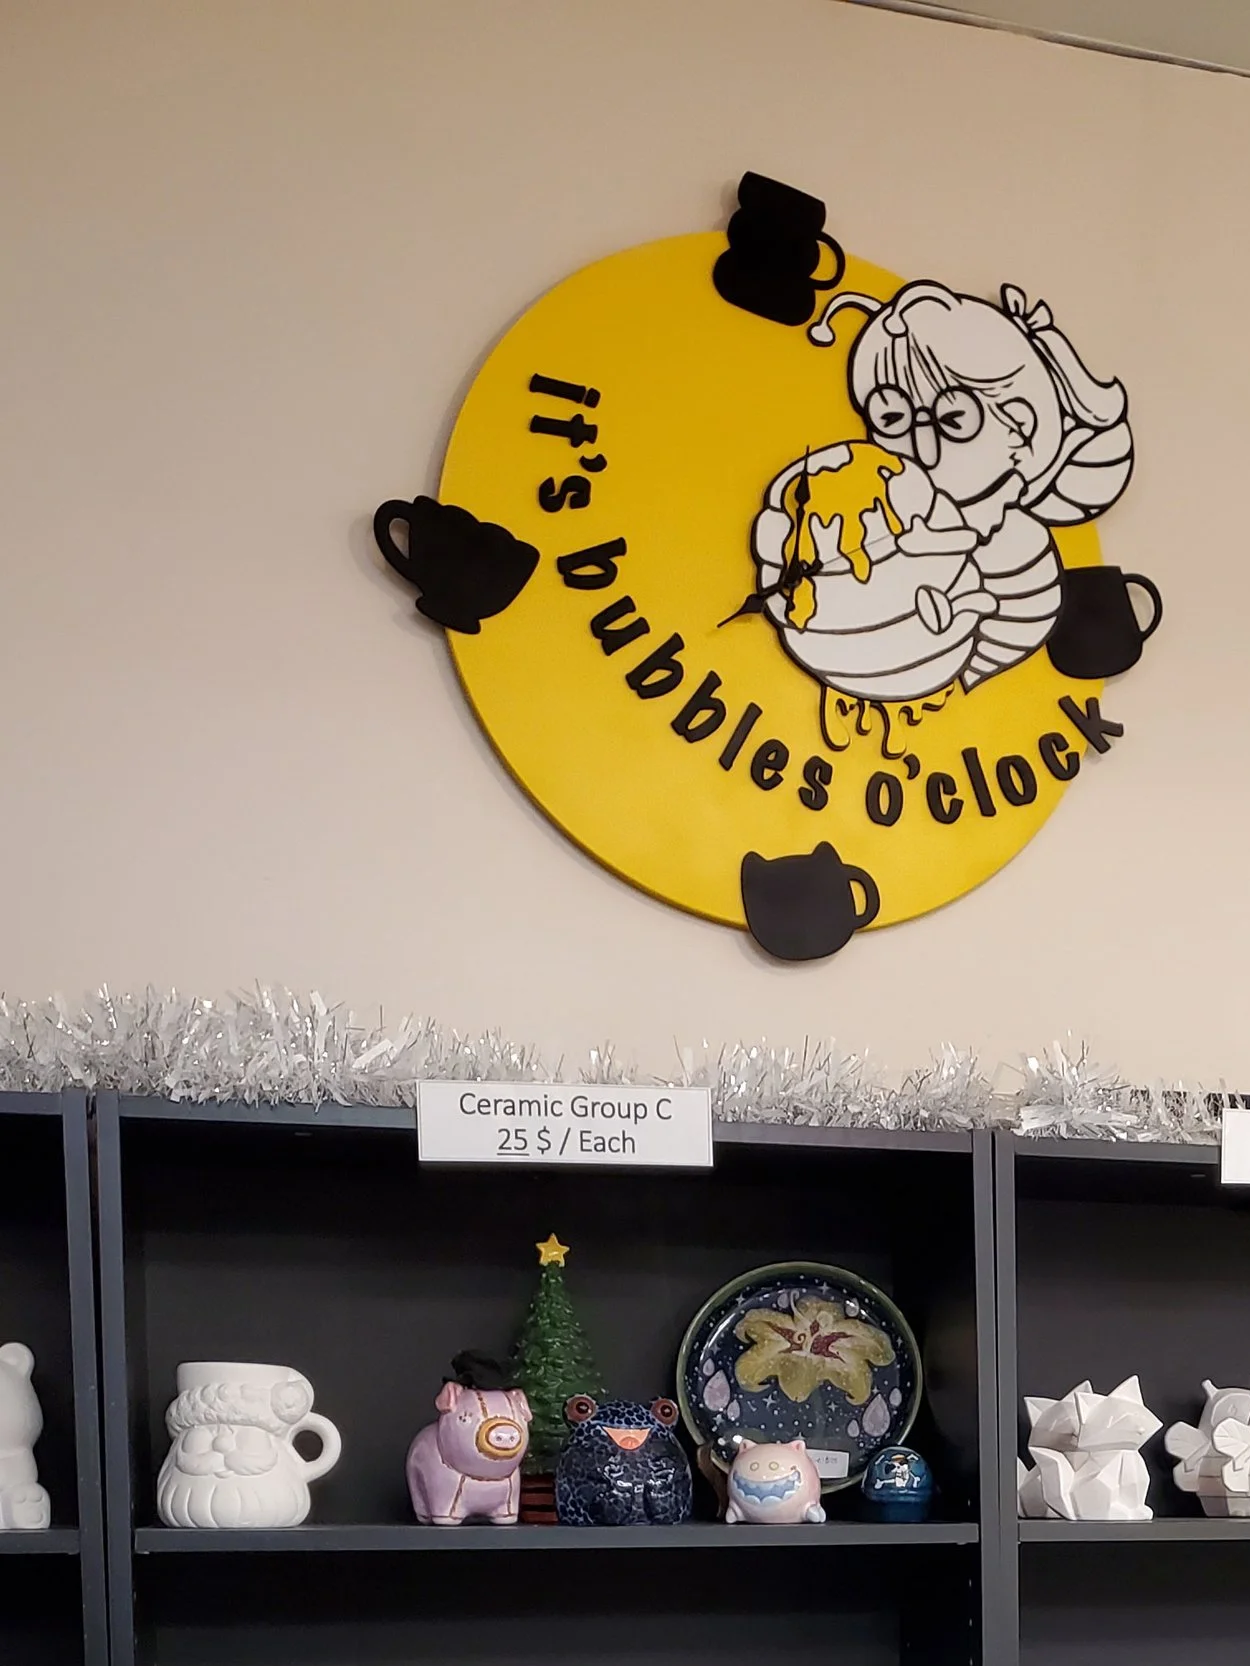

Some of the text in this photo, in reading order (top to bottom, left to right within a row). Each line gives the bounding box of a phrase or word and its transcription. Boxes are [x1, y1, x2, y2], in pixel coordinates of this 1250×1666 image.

[556, 536, 833, 812] bubbles
[865, 695, 1124, 827] o'clock
[459, 1092, 673, 1125] Ceramic Group C
[497, 1125, 637, 1156] 25 $ / Each
